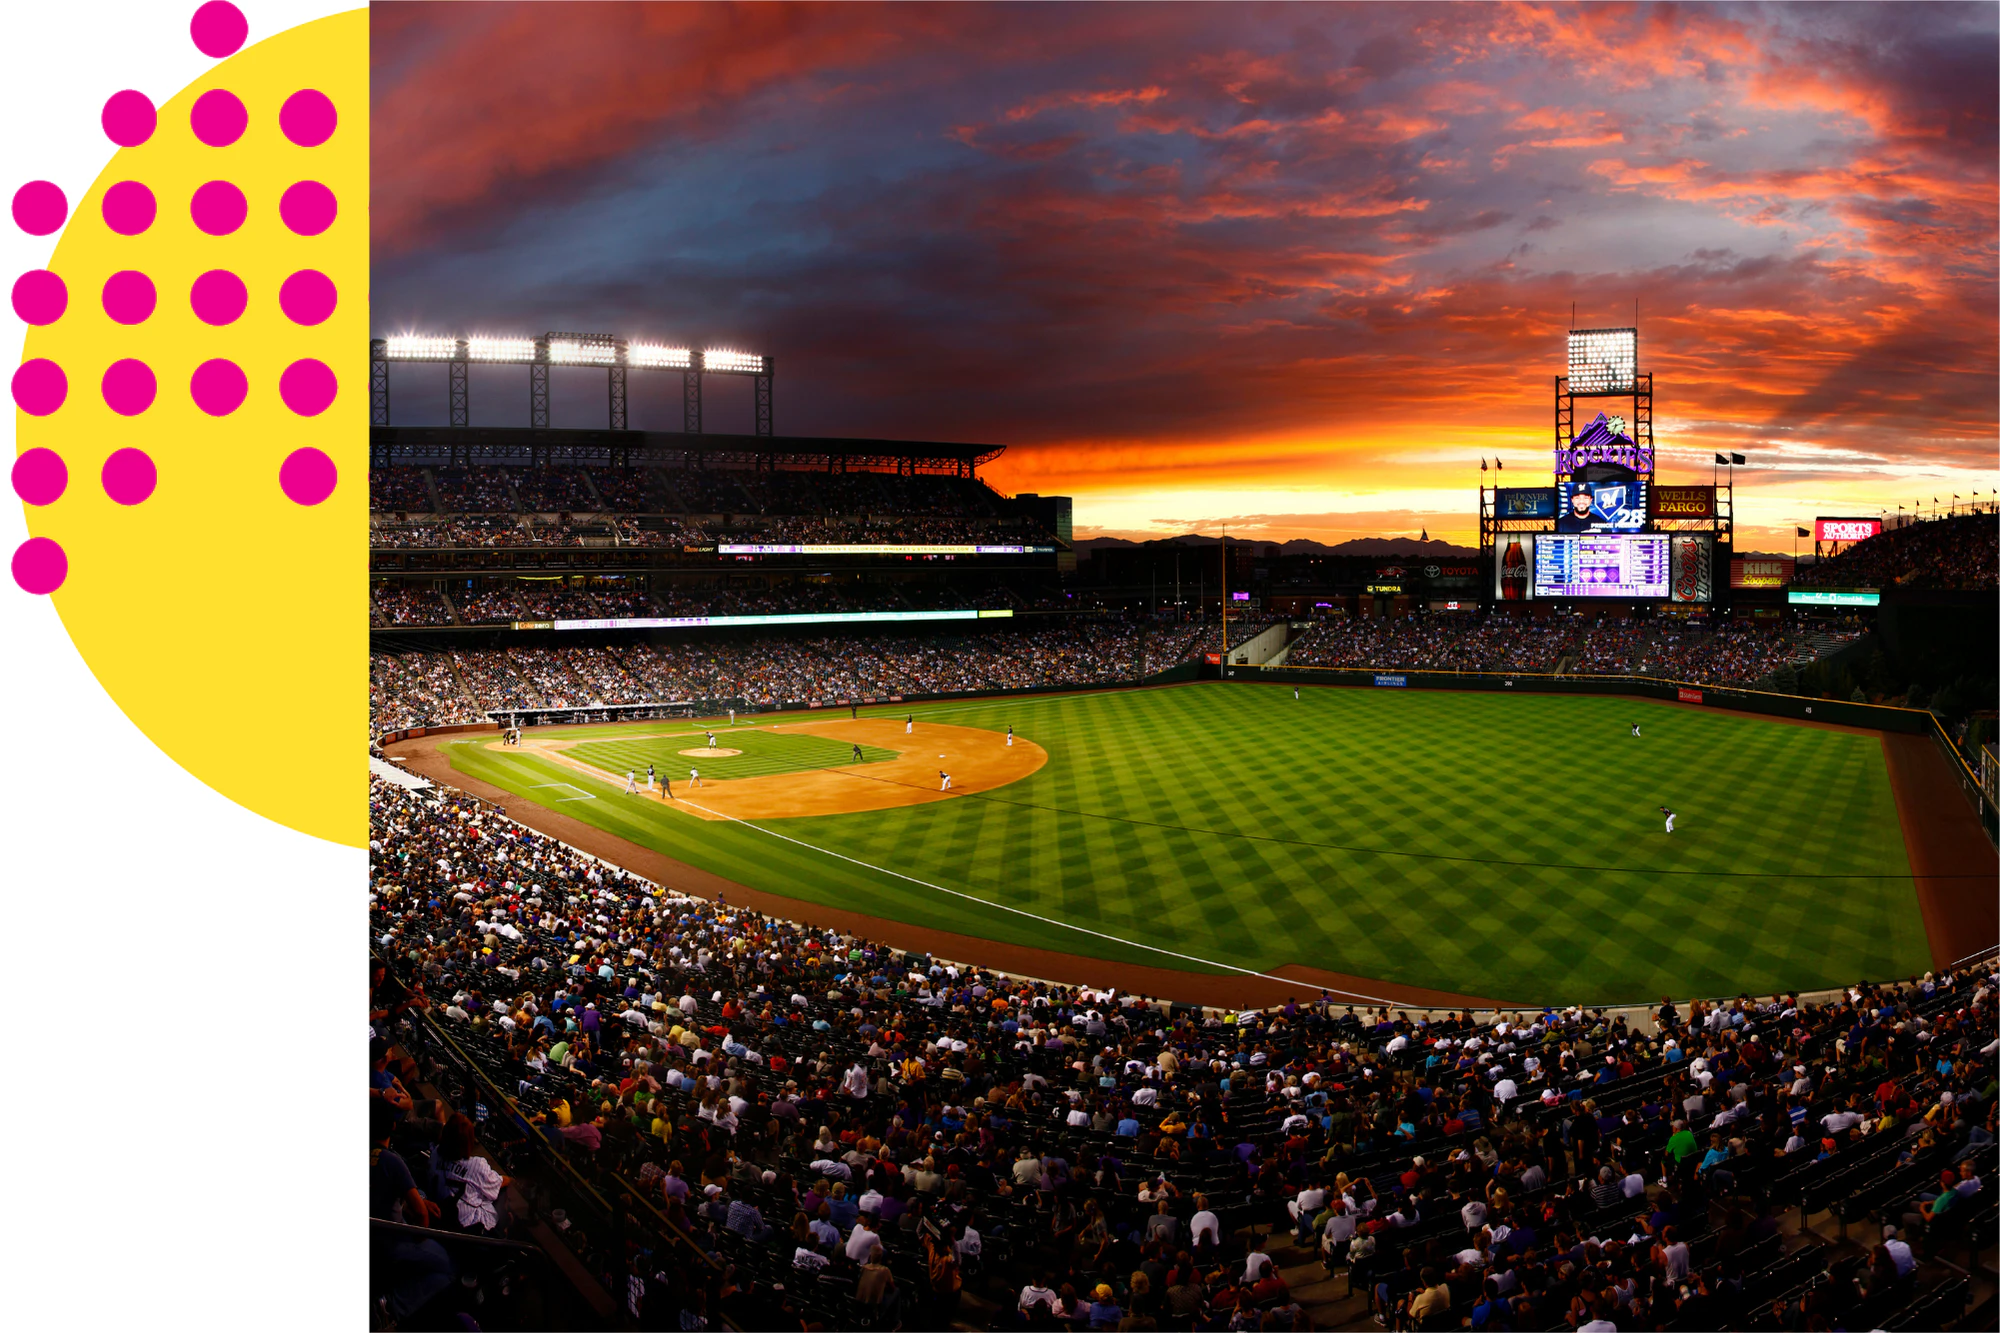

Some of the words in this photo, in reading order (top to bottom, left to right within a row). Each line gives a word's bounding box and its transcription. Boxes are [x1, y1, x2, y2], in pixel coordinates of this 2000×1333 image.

[1553, 447, 1653, 475] ROCKIES
[1516, 492, 1548, 501] DENVER
[1659, 490, 1707, 501] WELLS
[1659, 502, 1706, 512] FARGO
[1617, 509, 1643, 526] 28
[1823, 523, 1872, 533] SPORTS
[1441, 567, 1479, 576] TOYOTA
[1676, 540, 1697, 602] Coors
[1698, 543, 1709, 600] LIGHT
[1743, 562, 1782, 575] KING
[1375, 675, 1405, 683] FRONTIER
